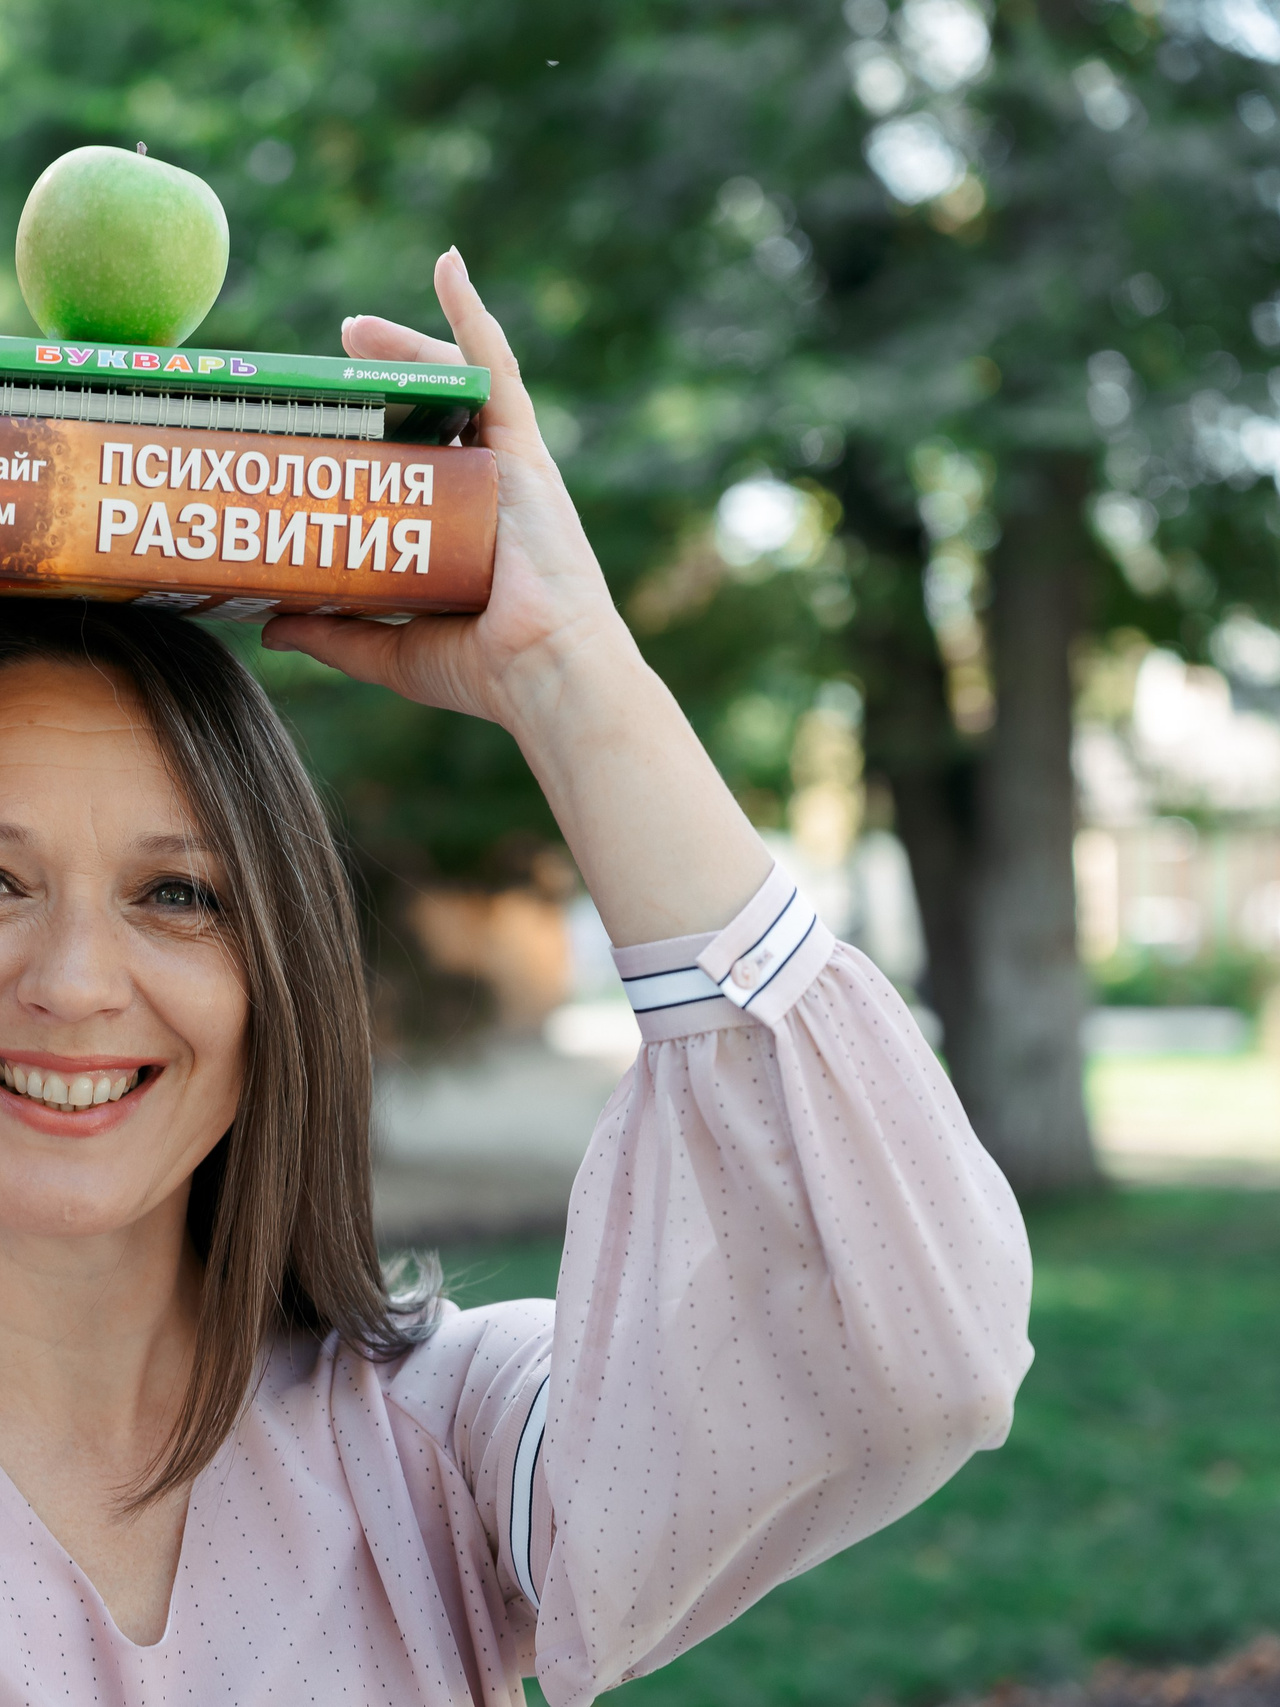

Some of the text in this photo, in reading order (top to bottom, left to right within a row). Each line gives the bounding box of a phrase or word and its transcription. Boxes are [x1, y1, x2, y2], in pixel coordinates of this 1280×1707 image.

[35, 345, 258, 377] БУКВАРЬ
[100, 442, 434, 506] ПСИХОЛОГИЯ
[97, 498, 432, 574] РАЗВИТИЯ
